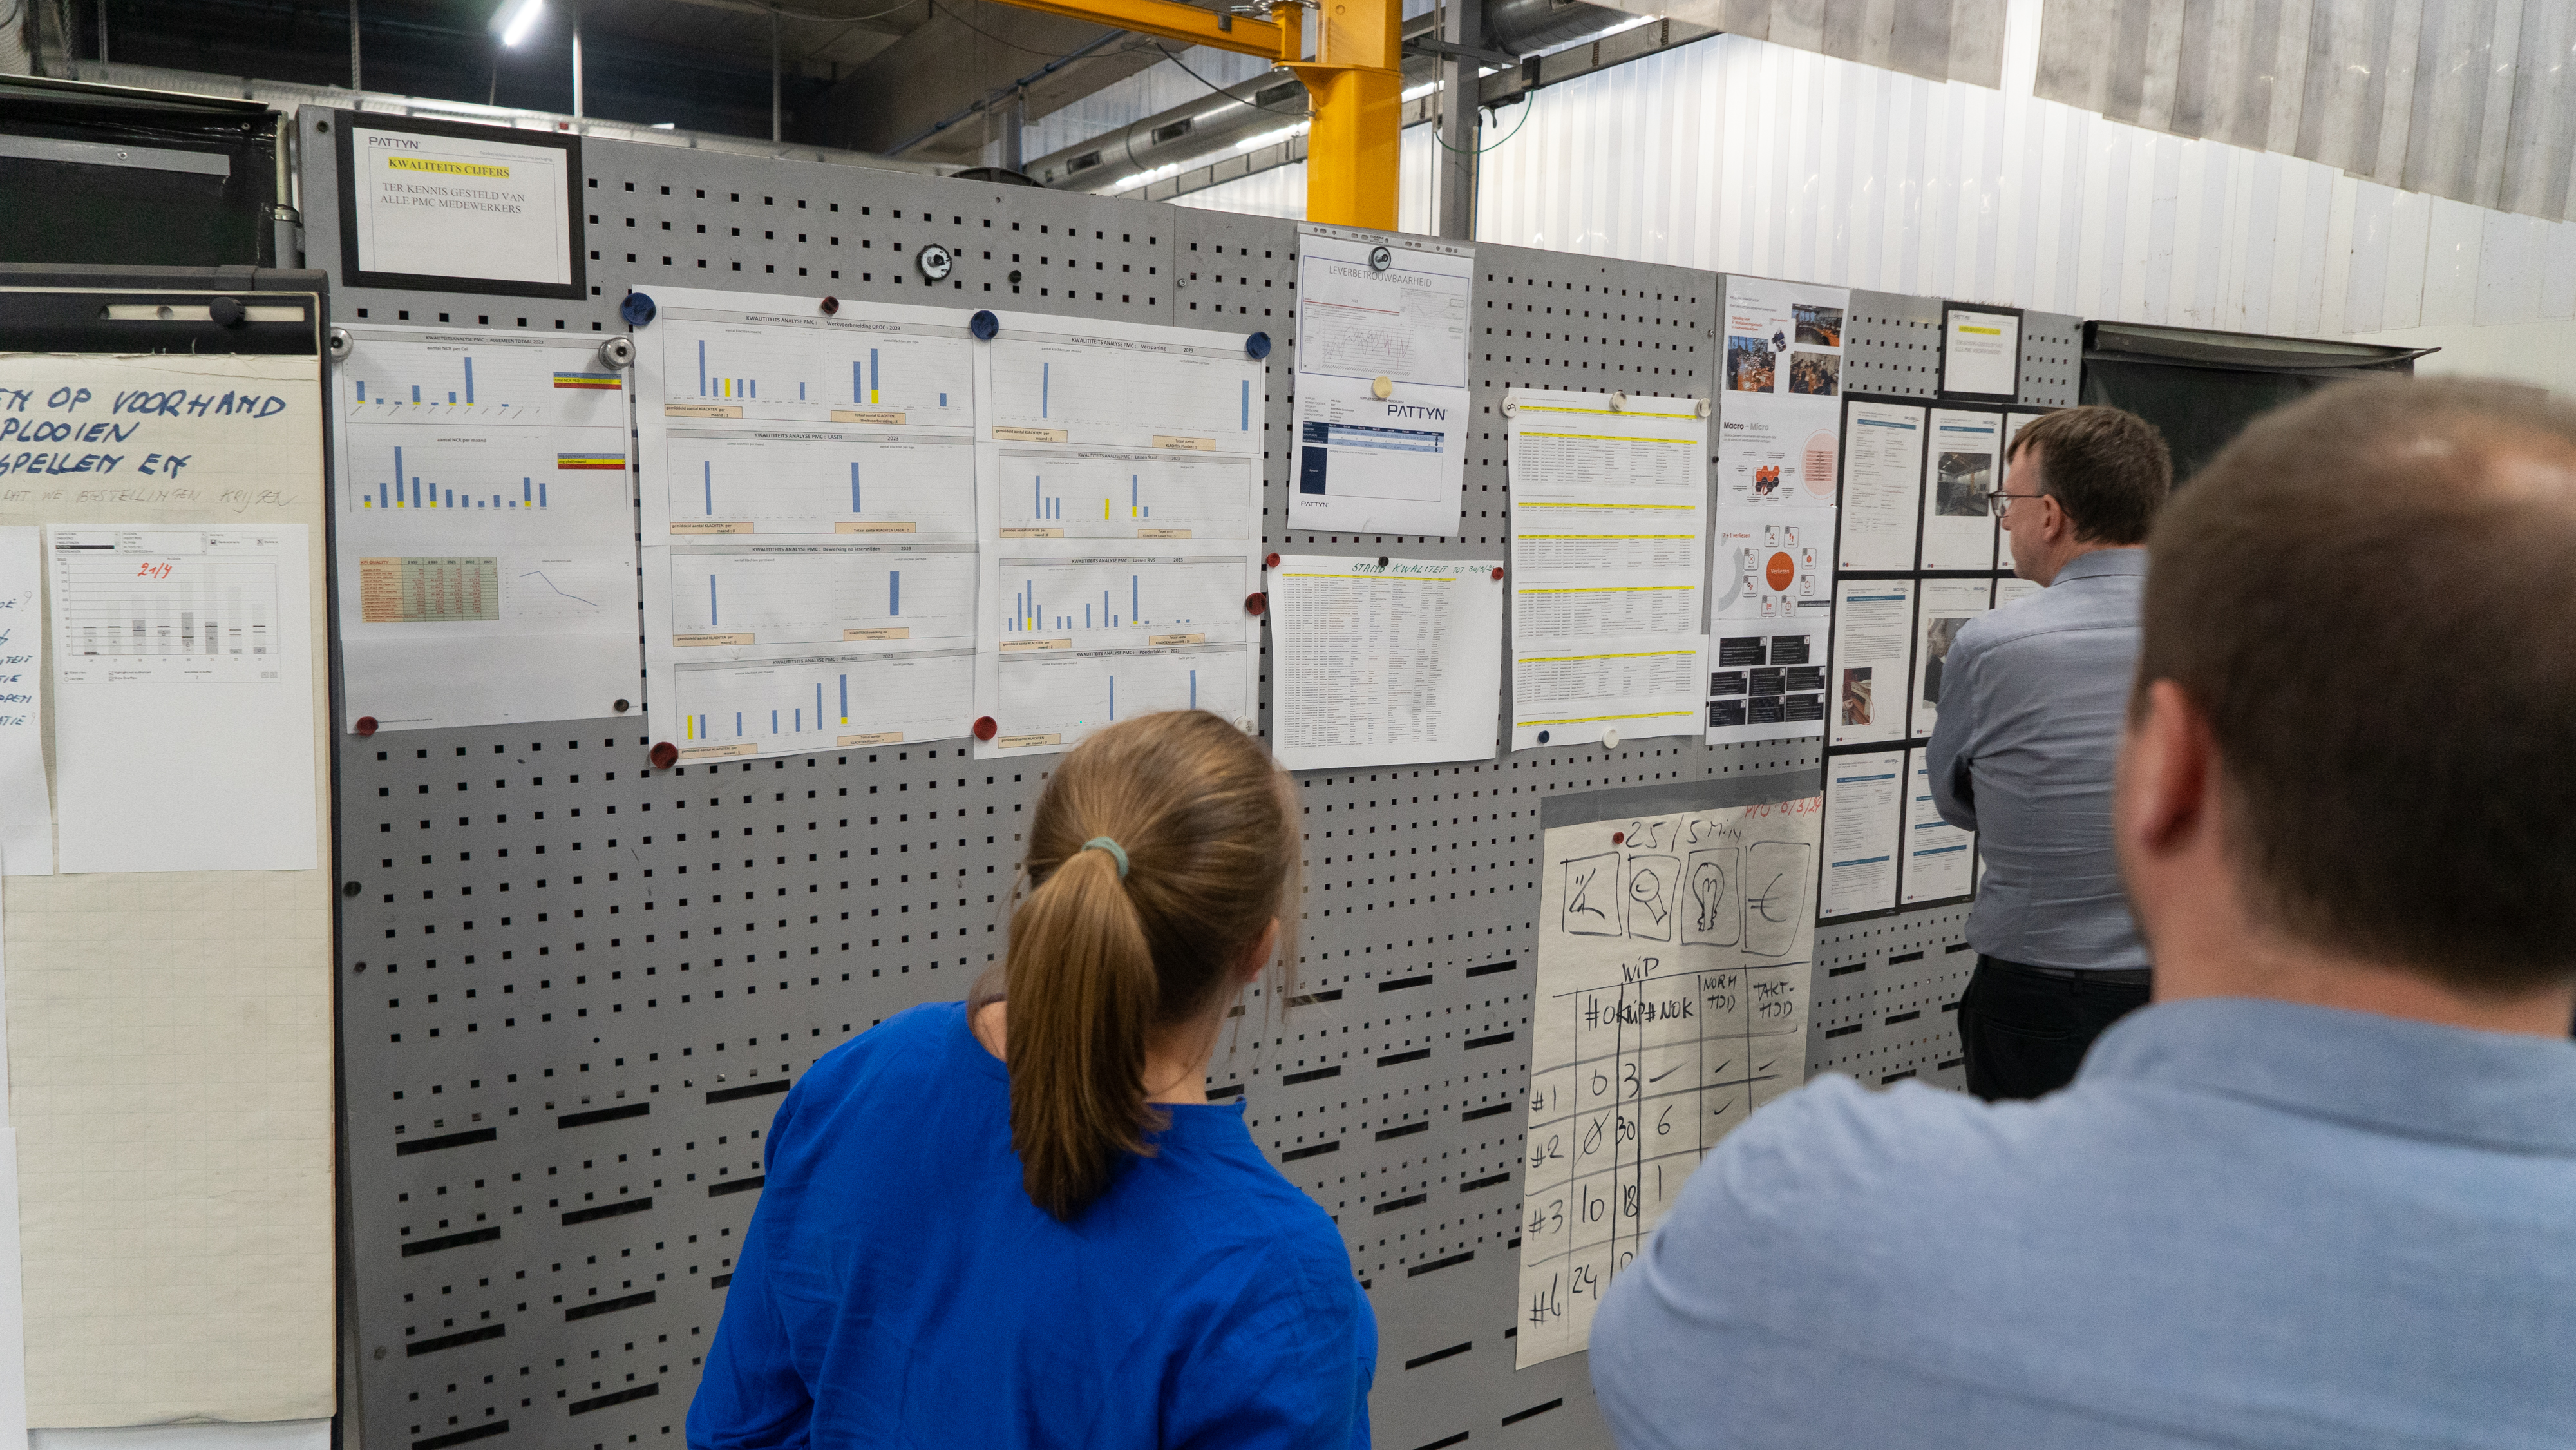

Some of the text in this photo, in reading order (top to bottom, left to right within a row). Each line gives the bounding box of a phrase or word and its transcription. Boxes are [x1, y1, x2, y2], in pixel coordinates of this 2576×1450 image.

[369, 137, 418, 149] PATTYN
[389, 158, 509, 177] KWALITEITS CIJFERS
[383, 182, 525, 202] TER KENNIS GESTELD VAN
[381, 195, 521, 213] ALLE PMC MEDEWERKERS
[1329, 265, 1432, 287] LEVERBETROUWBAARHEID
[826, 321, 871, 330] Werkvoorbereiding
[48, 387, 91, 413] OP
[113, 389, 287, 419] VOORHAND
[1387, 404, 1445, 421] PATTYN
[0, 417, 140, 443] PLOOIEN
[1723, 421, 1769, 431] Macro Micro
[3, 490, 31, 501] DAT
[42, 490, 64, 501] WE
[1392, 562, 1448, 573] KWALITEIT
[1528, 1199, 1564, 1241] #3
[1582, 1184, 1605, 1223] 10
[1572, 1264, 1598, 1301] 24
